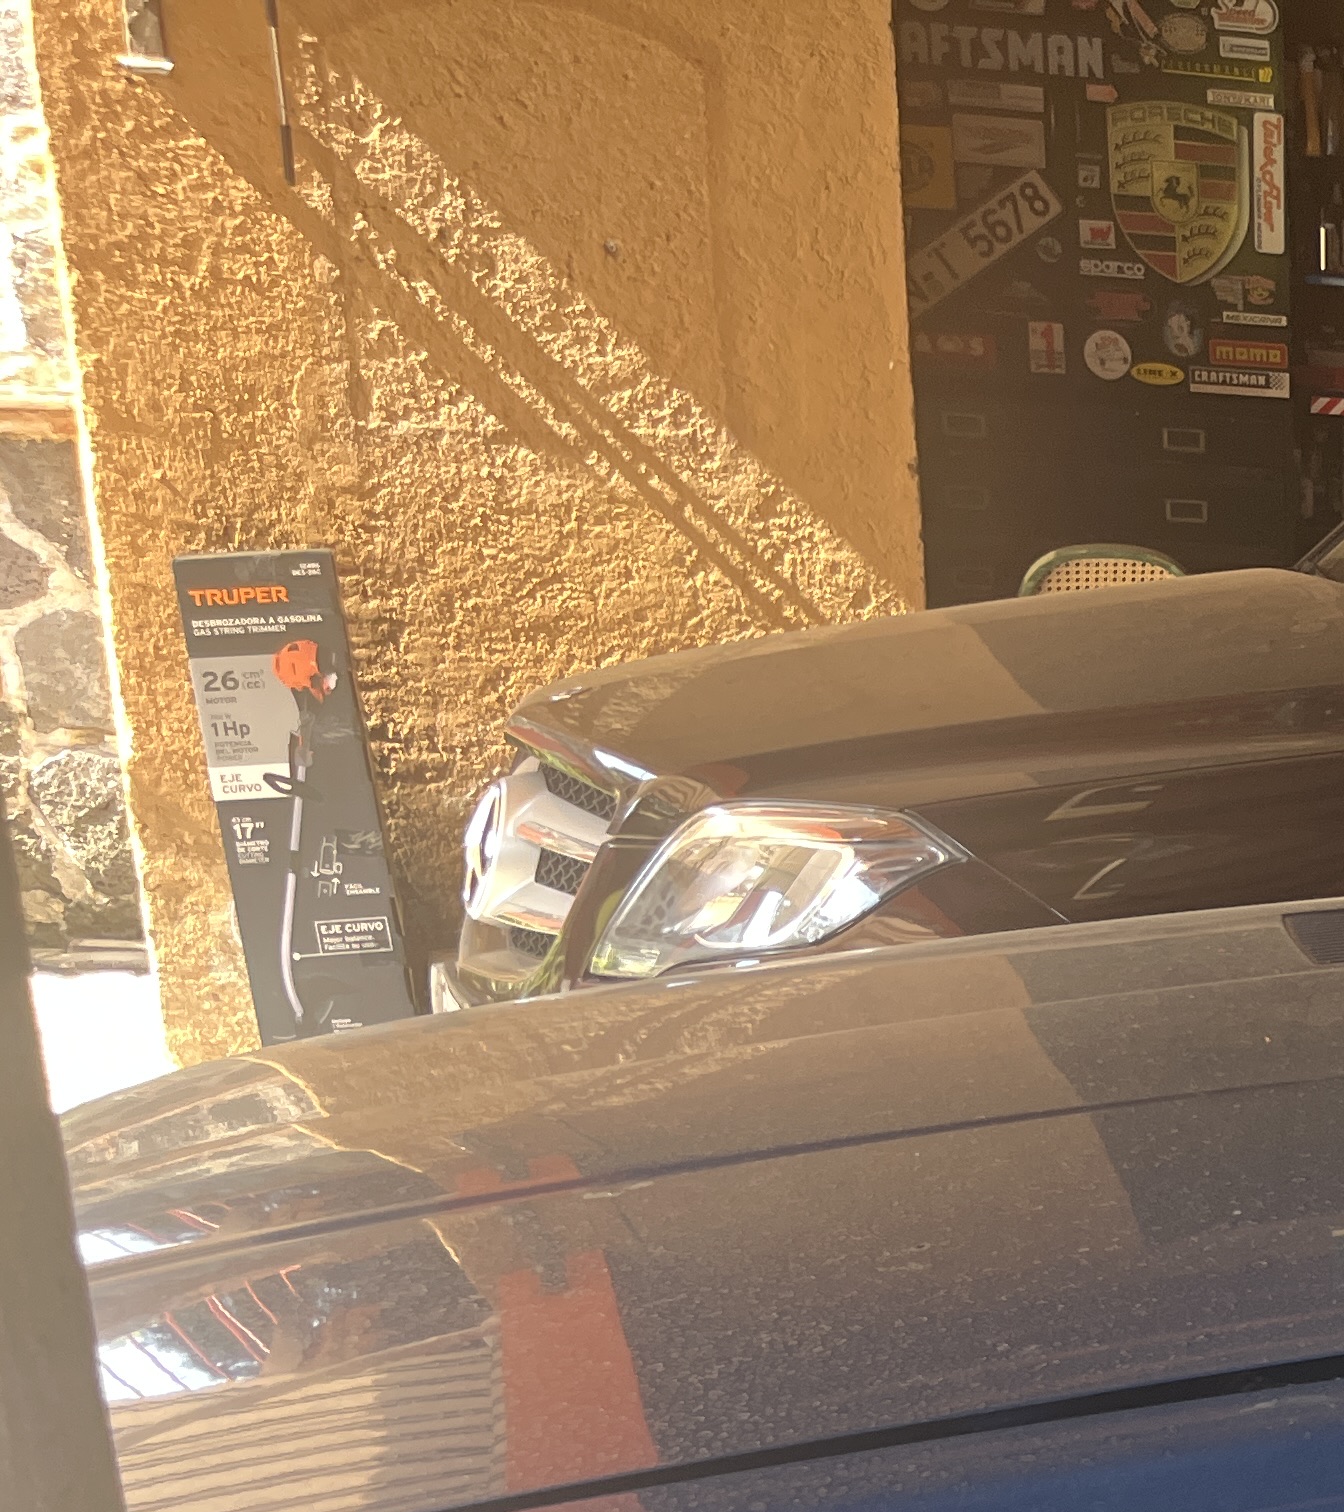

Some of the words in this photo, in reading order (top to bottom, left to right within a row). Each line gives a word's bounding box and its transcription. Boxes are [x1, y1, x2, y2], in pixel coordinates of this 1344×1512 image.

[957, 182, 1050, 259] 5678
[1079, 257, 1145, 278] sparco
[1193, 371, 1267, 387] CRAFTSMAN
[187, 586, 290, 607] TRUPER
[191, 617, 266, 629] DESBROZADORA
[277, 614, 323, 625] GASOLINA
[193, 629, 212, 638] GAS
[213, 626, 245, 636] STRING
[248, 624, 287, 635] TRIMMER
[202, 670, 240, 692] 26
[205, 697, 237, 705] MOTOR
[220, 773, 243, 784] EJE
[222, 783, 263, 794] CURVO
[320, 925, 343, 935] EJE
[345, 922, 384, 934] CURVO
